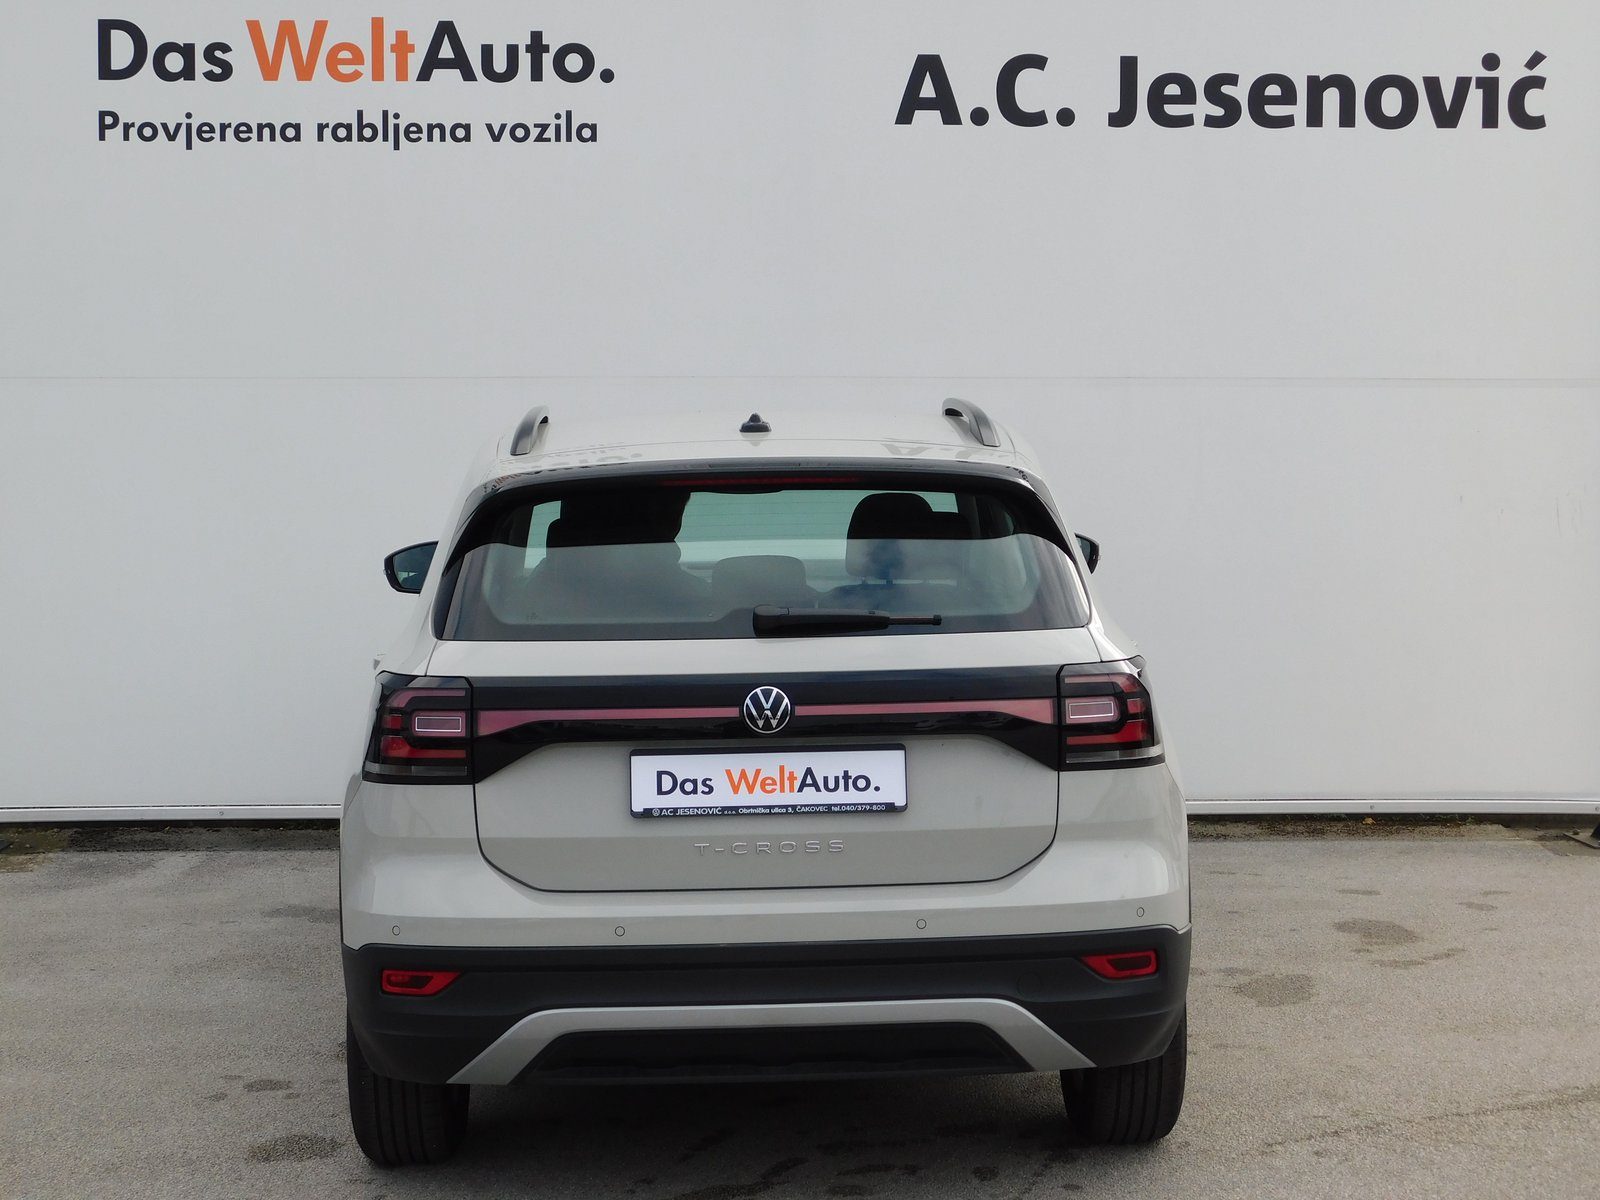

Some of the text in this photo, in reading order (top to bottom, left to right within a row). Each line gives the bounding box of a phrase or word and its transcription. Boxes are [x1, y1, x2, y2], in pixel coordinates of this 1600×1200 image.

[97, 16, 616, 84] Das WeltAuto.
[894, 50, 1548, 130] A.C. Jesenović
[98, 109, 599, 151] Provjerena rabljena vozila
[656, 765, 881, 796] Das WeltAuto.
[661, 808, 674, 816] AC
[676, 806, 722, 816] JESENOVIĆ
[738, 806, 770, 814] Obrtnička
[796, 805, 828, 813] ČAKOVEC
[694, 839, 845, 856] T-CROSS
